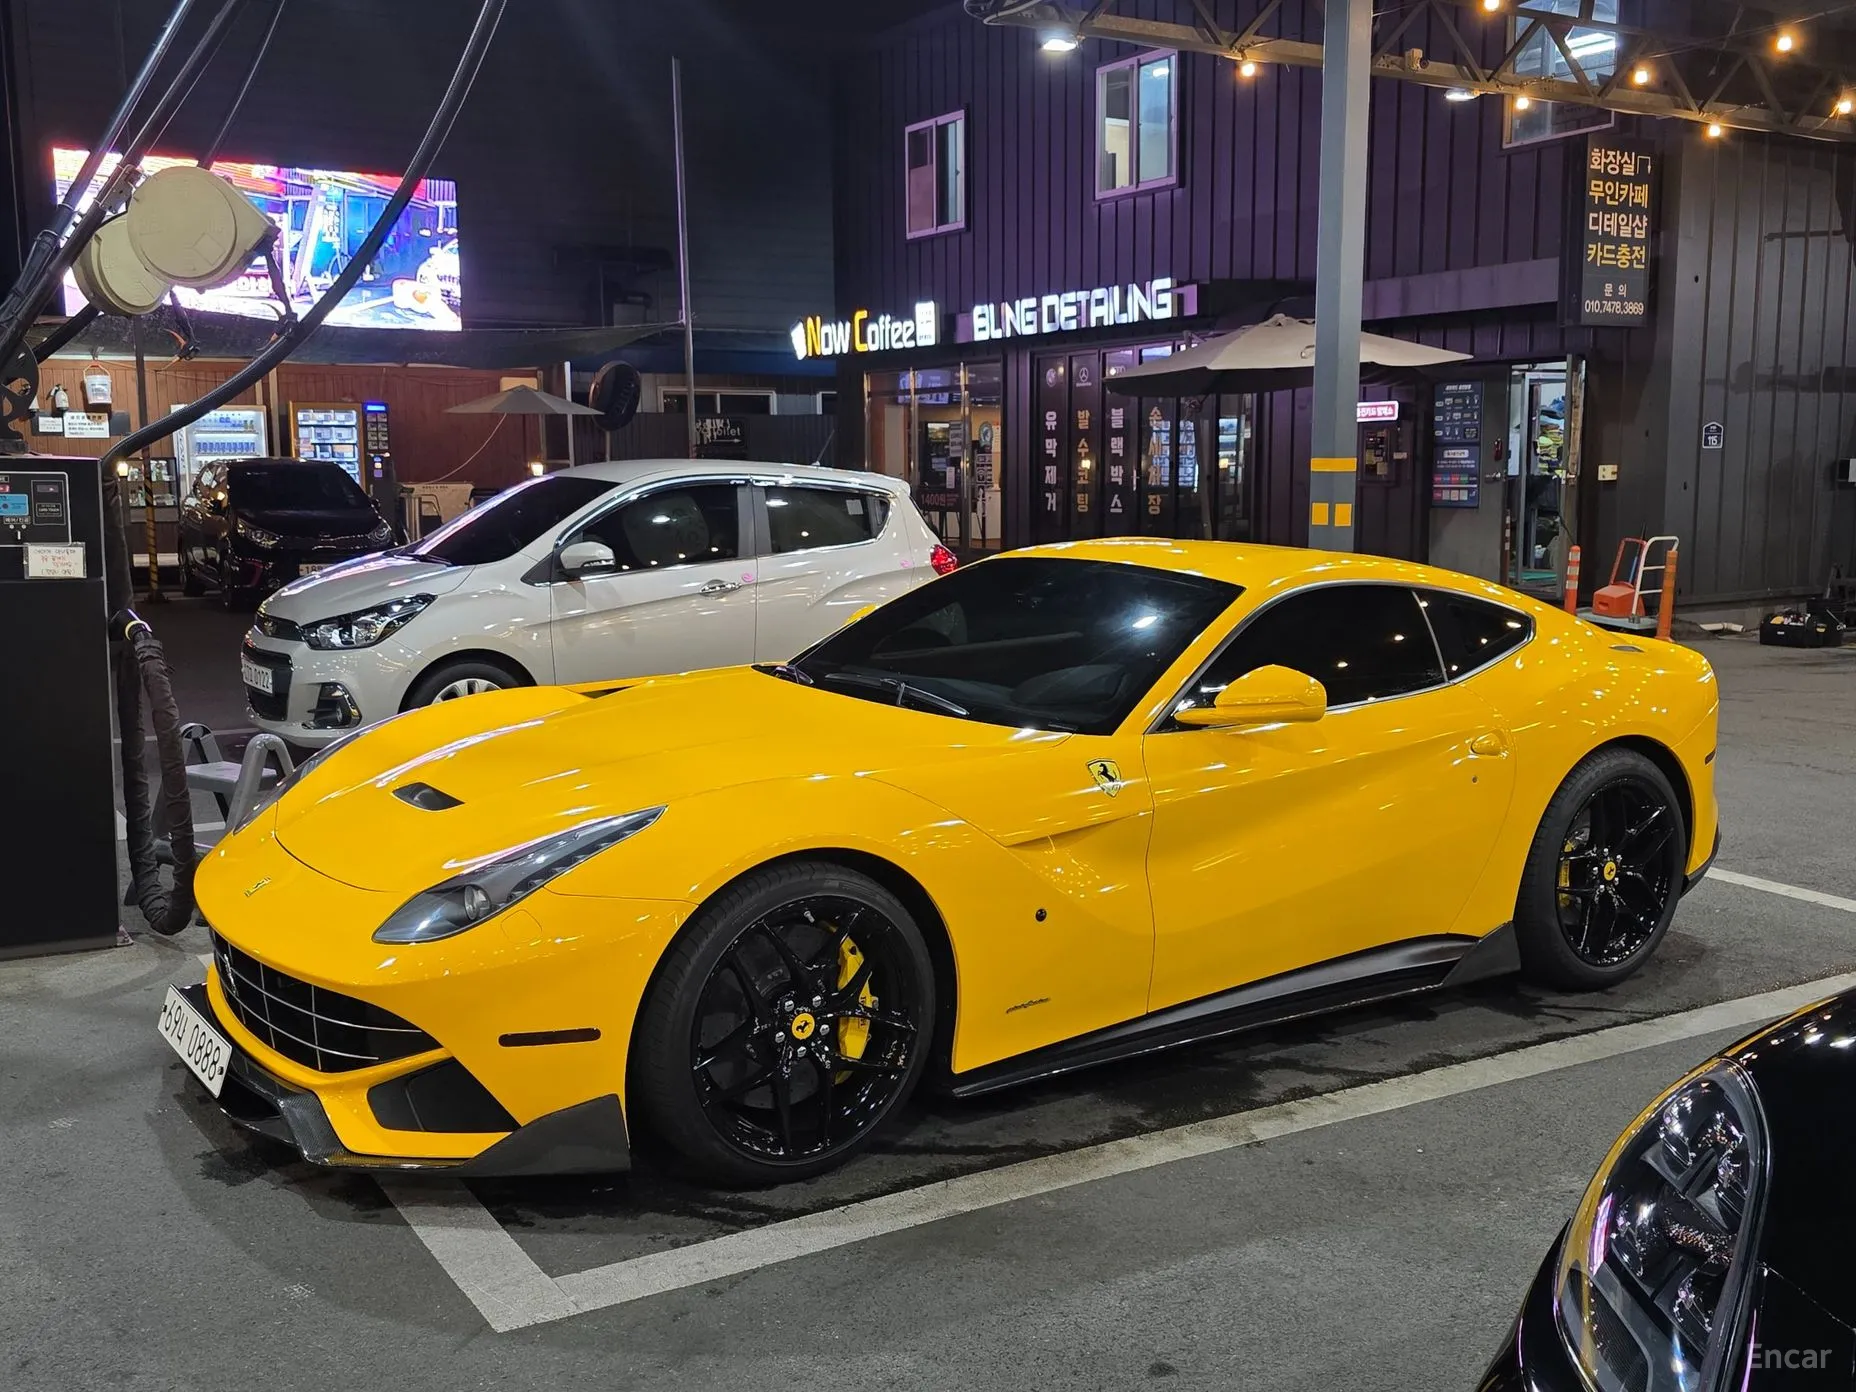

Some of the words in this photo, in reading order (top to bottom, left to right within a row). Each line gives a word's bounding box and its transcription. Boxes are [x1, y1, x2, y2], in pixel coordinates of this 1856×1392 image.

[1590, 148, 1635, 176] 화장실
[1589, 180, 1648, 208] 무인카페
[1588, 211, 1648, 238] 디테일샵
[1587, 243, 1645, 269] 카드충전
[973, 297, 1037, 341] BLING
[1041, 277, 1172, 334] DETAILING
[1584, 300, 1644, 315] 010.7478.3869
[807, 315, 850, 357] Now
[854, 309, 915, 352] Coffee
[1045, 411, 1057, 512] 유막제거
[1077, 409, 1090, 513] 발수코팅
[1110, 408, 1124, 513] 블랙박스
[188, 1024, 221, 1081] 0888
